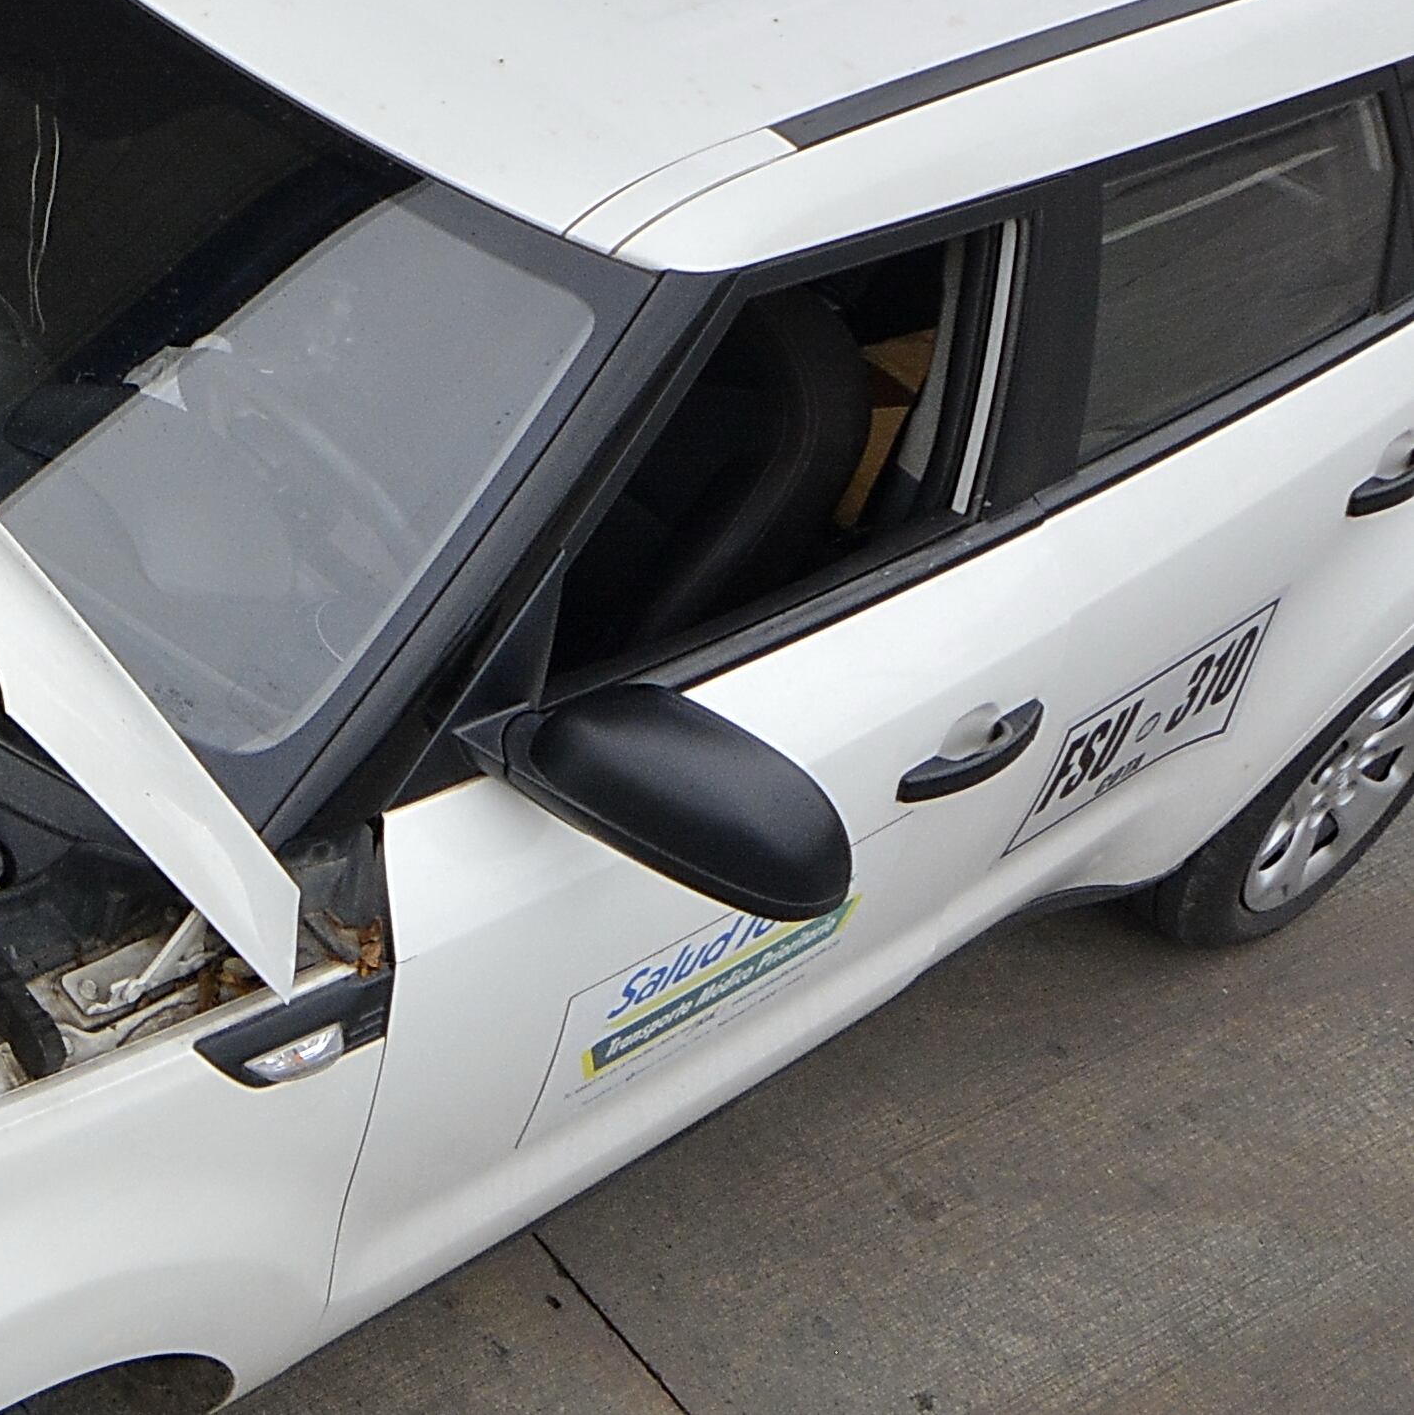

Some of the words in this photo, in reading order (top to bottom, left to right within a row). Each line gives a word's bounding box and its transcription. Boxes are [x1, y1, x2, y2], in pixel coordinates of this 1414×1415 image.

[1034, 698, 1146, 816] FSU
[1163, 625, 1260, 734] 310
[607, 915, 746, 1020] Salud
[604, 998, 694, 1059] Transporte
